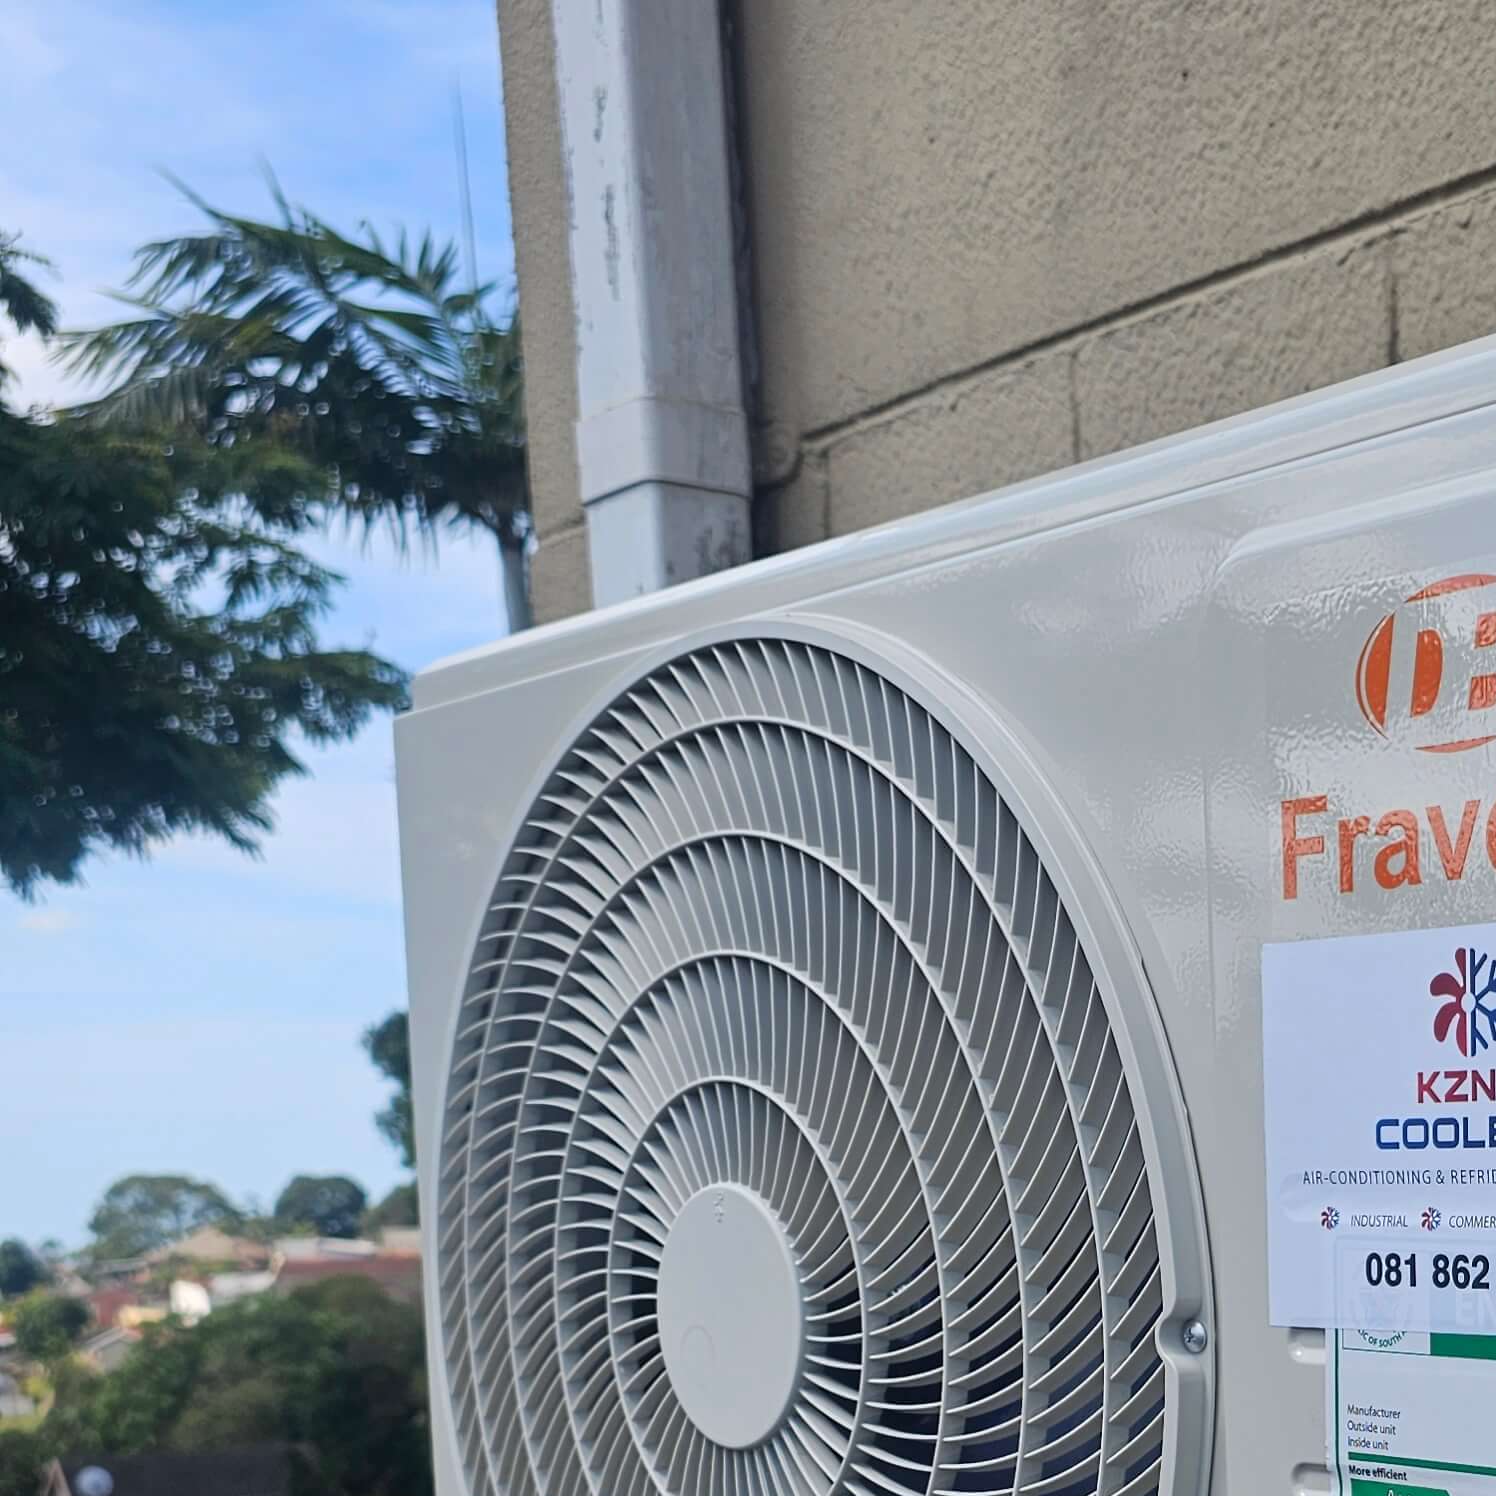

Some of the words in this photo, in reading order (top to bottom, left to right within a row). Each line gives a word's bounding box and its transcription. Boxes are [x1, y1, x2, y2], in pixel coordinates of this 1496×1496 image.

[1303, 1169, 1432, 1185] AIR-CONDITIONING
[1435, 1170, 1446, 1185] &
[1350, 1215, 1409, 1228] INDUSTRIAL
[1365, 1252, 1418, 1287] 081
[1431, 1254, 1490, 1290] 862
[1347, 1404, 1401, 1419] Manufacturer
[1347, 1420, 1378, 1433] Outside
[1380, 1425, 1396, 1435] unit
[1347, 1436, 1371, 1448] Inside
[1372, 1440, 1389, 1450] unit
[1349, 1465, 1371, 1477] More
[1372, 1467, 1408, 1481] efficient
